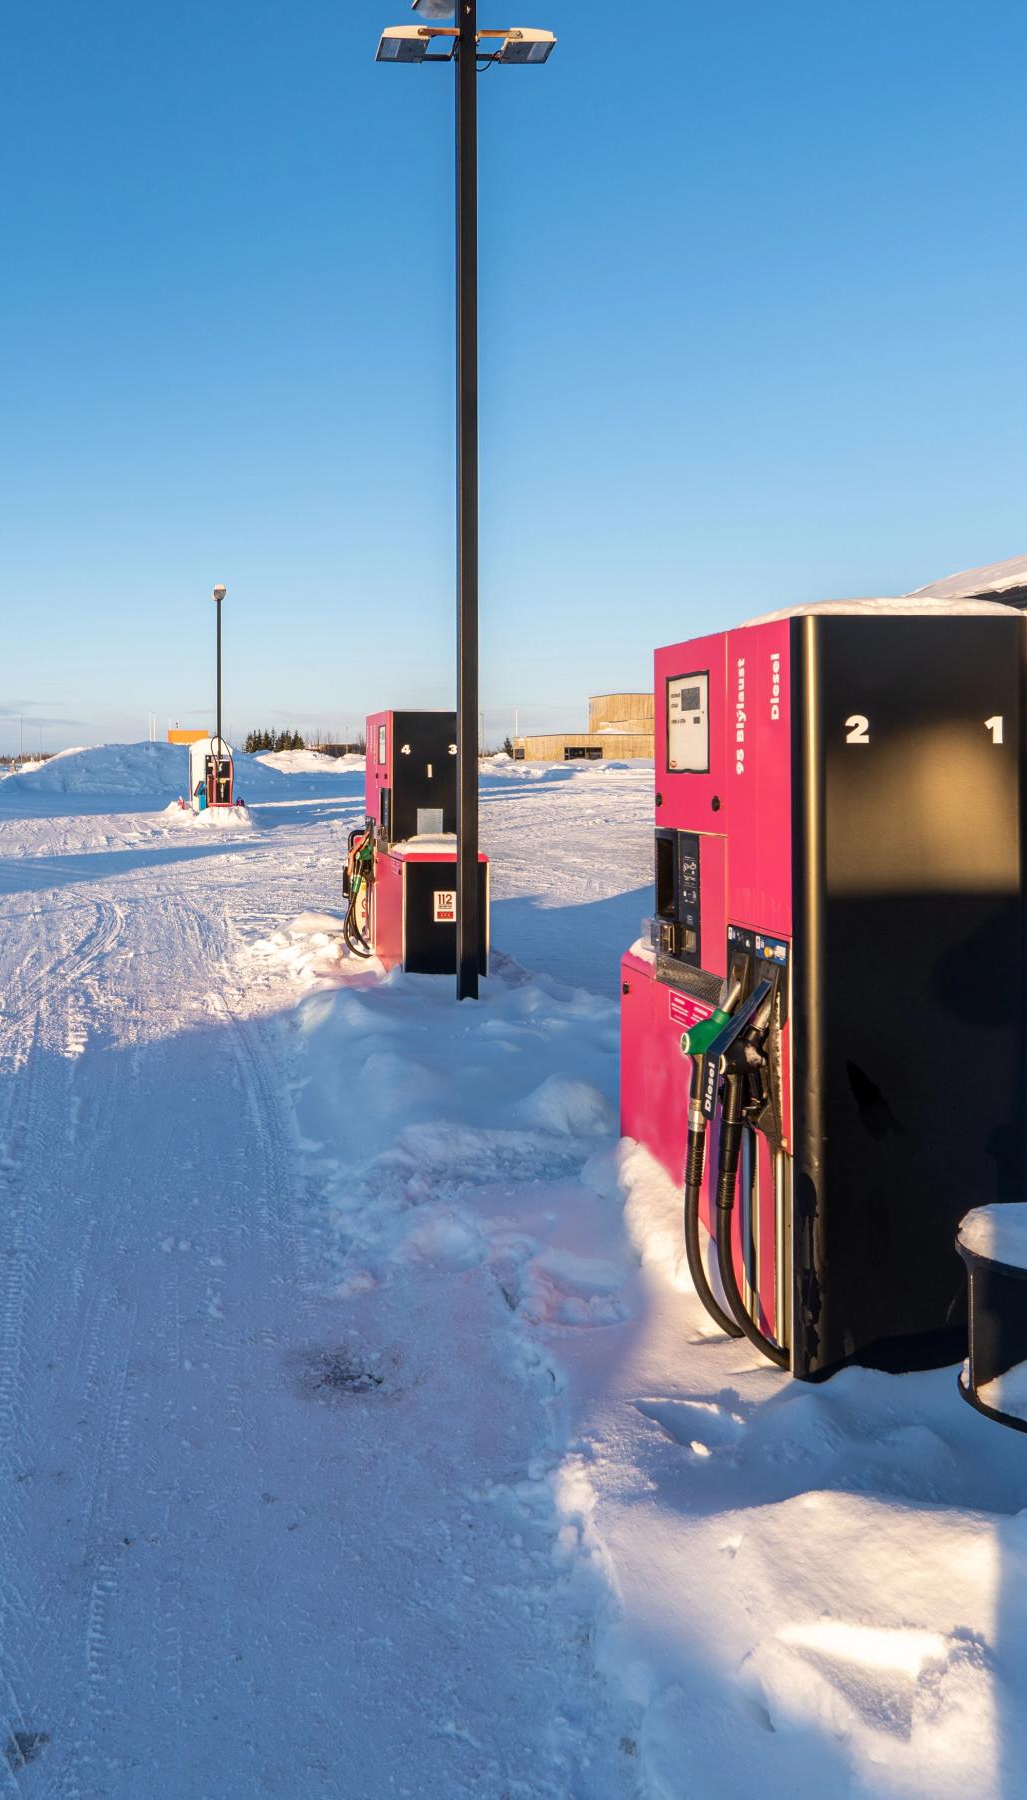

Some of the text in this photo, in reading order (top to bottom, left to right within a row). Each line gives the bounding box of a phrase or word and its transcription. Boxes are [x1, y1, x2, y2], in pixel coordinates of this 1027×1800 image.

[770, 653, 780, 720] Diesel
[845, 714, 870, 744] 2
[984, 716, 1003, 744] 1
[400, 744, 411, 755] 4
[447, 744, 458, 755] 3
[736, 748, 745, 775] 95
[437, 893, 453, 905] 112
[704, 1061, 716, 1113] Diesel
